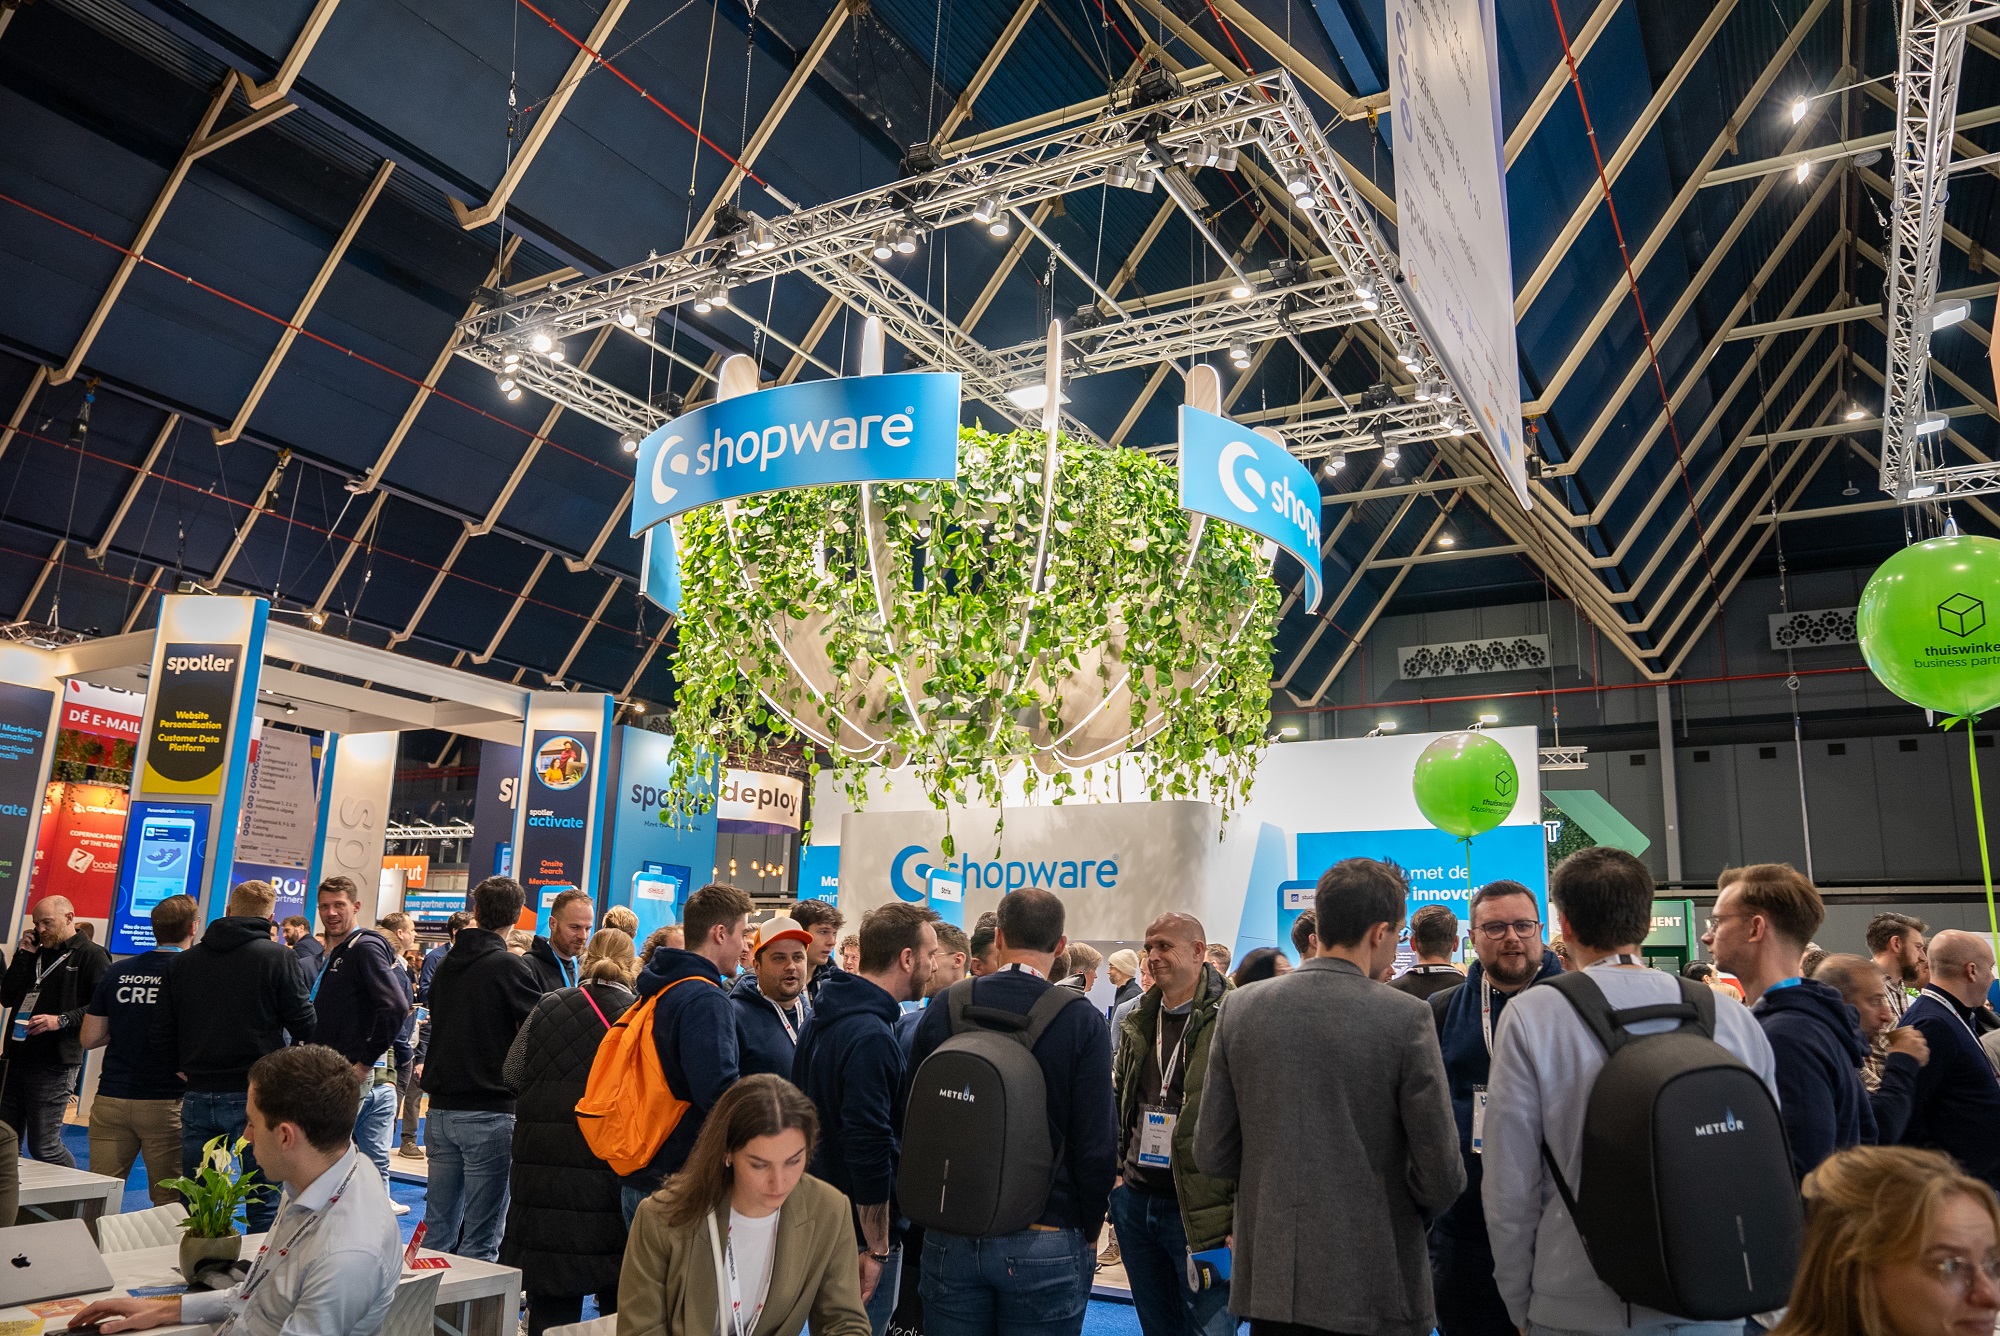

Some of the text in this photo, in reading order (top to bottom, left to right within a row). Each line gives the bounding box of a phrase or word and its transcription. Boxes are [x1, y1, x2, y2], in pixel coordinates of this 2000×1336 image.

[1404, 188, 1437, 267] spotler
[166, 654, 235, 675] spotler
[1913, 656, 2000, 669] business part
[68, 709, 141, 734] DÉ E-MAIL
[175, 711, 210, 720] Website
[2, 723, 43, 739] Marketing
[159, 719, 222, 730] Personalisation
[157, 733, 220, 744] Customer Data
[0, 745, 34, 755] actional
[168, 743, 206, 752] Platform
[529, 809, 554, 818] spotler
[528, 815, 584, 829] activate
[541, 859, 564, 868] Onsite
[540, 867, 564, 875] Search
[1410, 865, 1469, 880] met de
[421, 899, 445, 910] partner
[446, 901, 460, 909] voor
[118, 975, 162, 985] SHOPW
[116, 987, 160, 1004] CRE
[939, 1087, 975, 1102] METEOR
[1695, 1116, 1745, 1136] METEOR
[286, 1215, 318, 1248] COPERNICA
[887, 1321, 925, 1336] Medi
